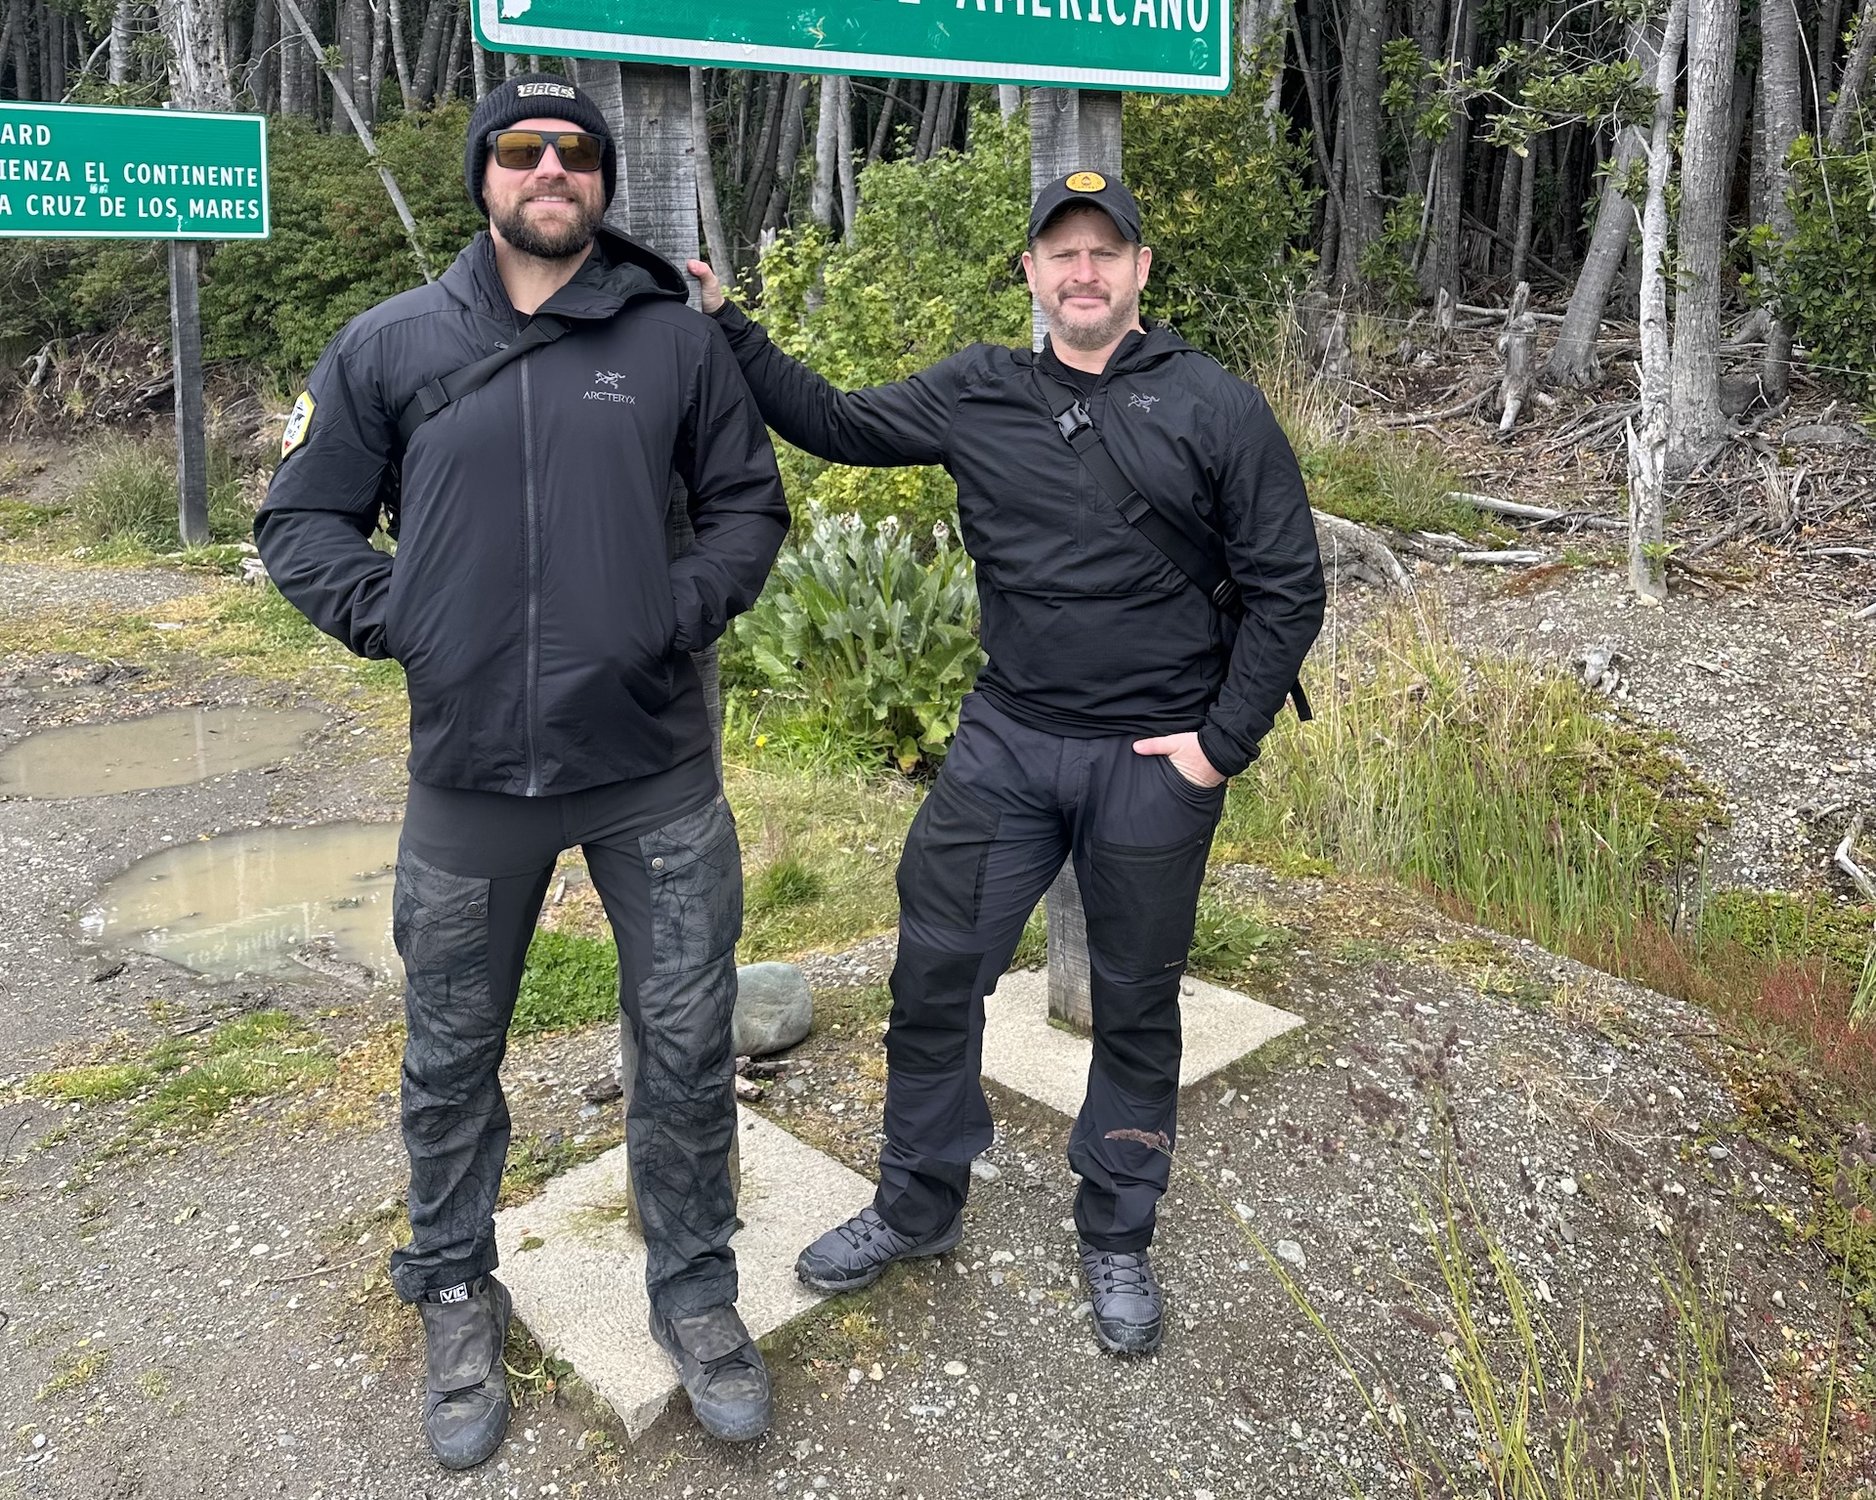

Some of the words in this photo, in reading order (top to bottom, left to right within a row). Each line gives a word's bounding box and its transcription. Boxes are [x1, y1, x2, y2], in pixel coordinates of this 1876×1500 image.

[1, 123, 50, 145] ARD
[85, 162, 109, 182] EL
[123, 163, 257, 187] CONTINENTE
[26, 194, 86, 216] CRUZ
[100, 196, 126, 217] DE
[138, 197, 177, 218] LOS
[189, 198, 259, 219] MARES
[442, 1285, 465, 1300] VIC
